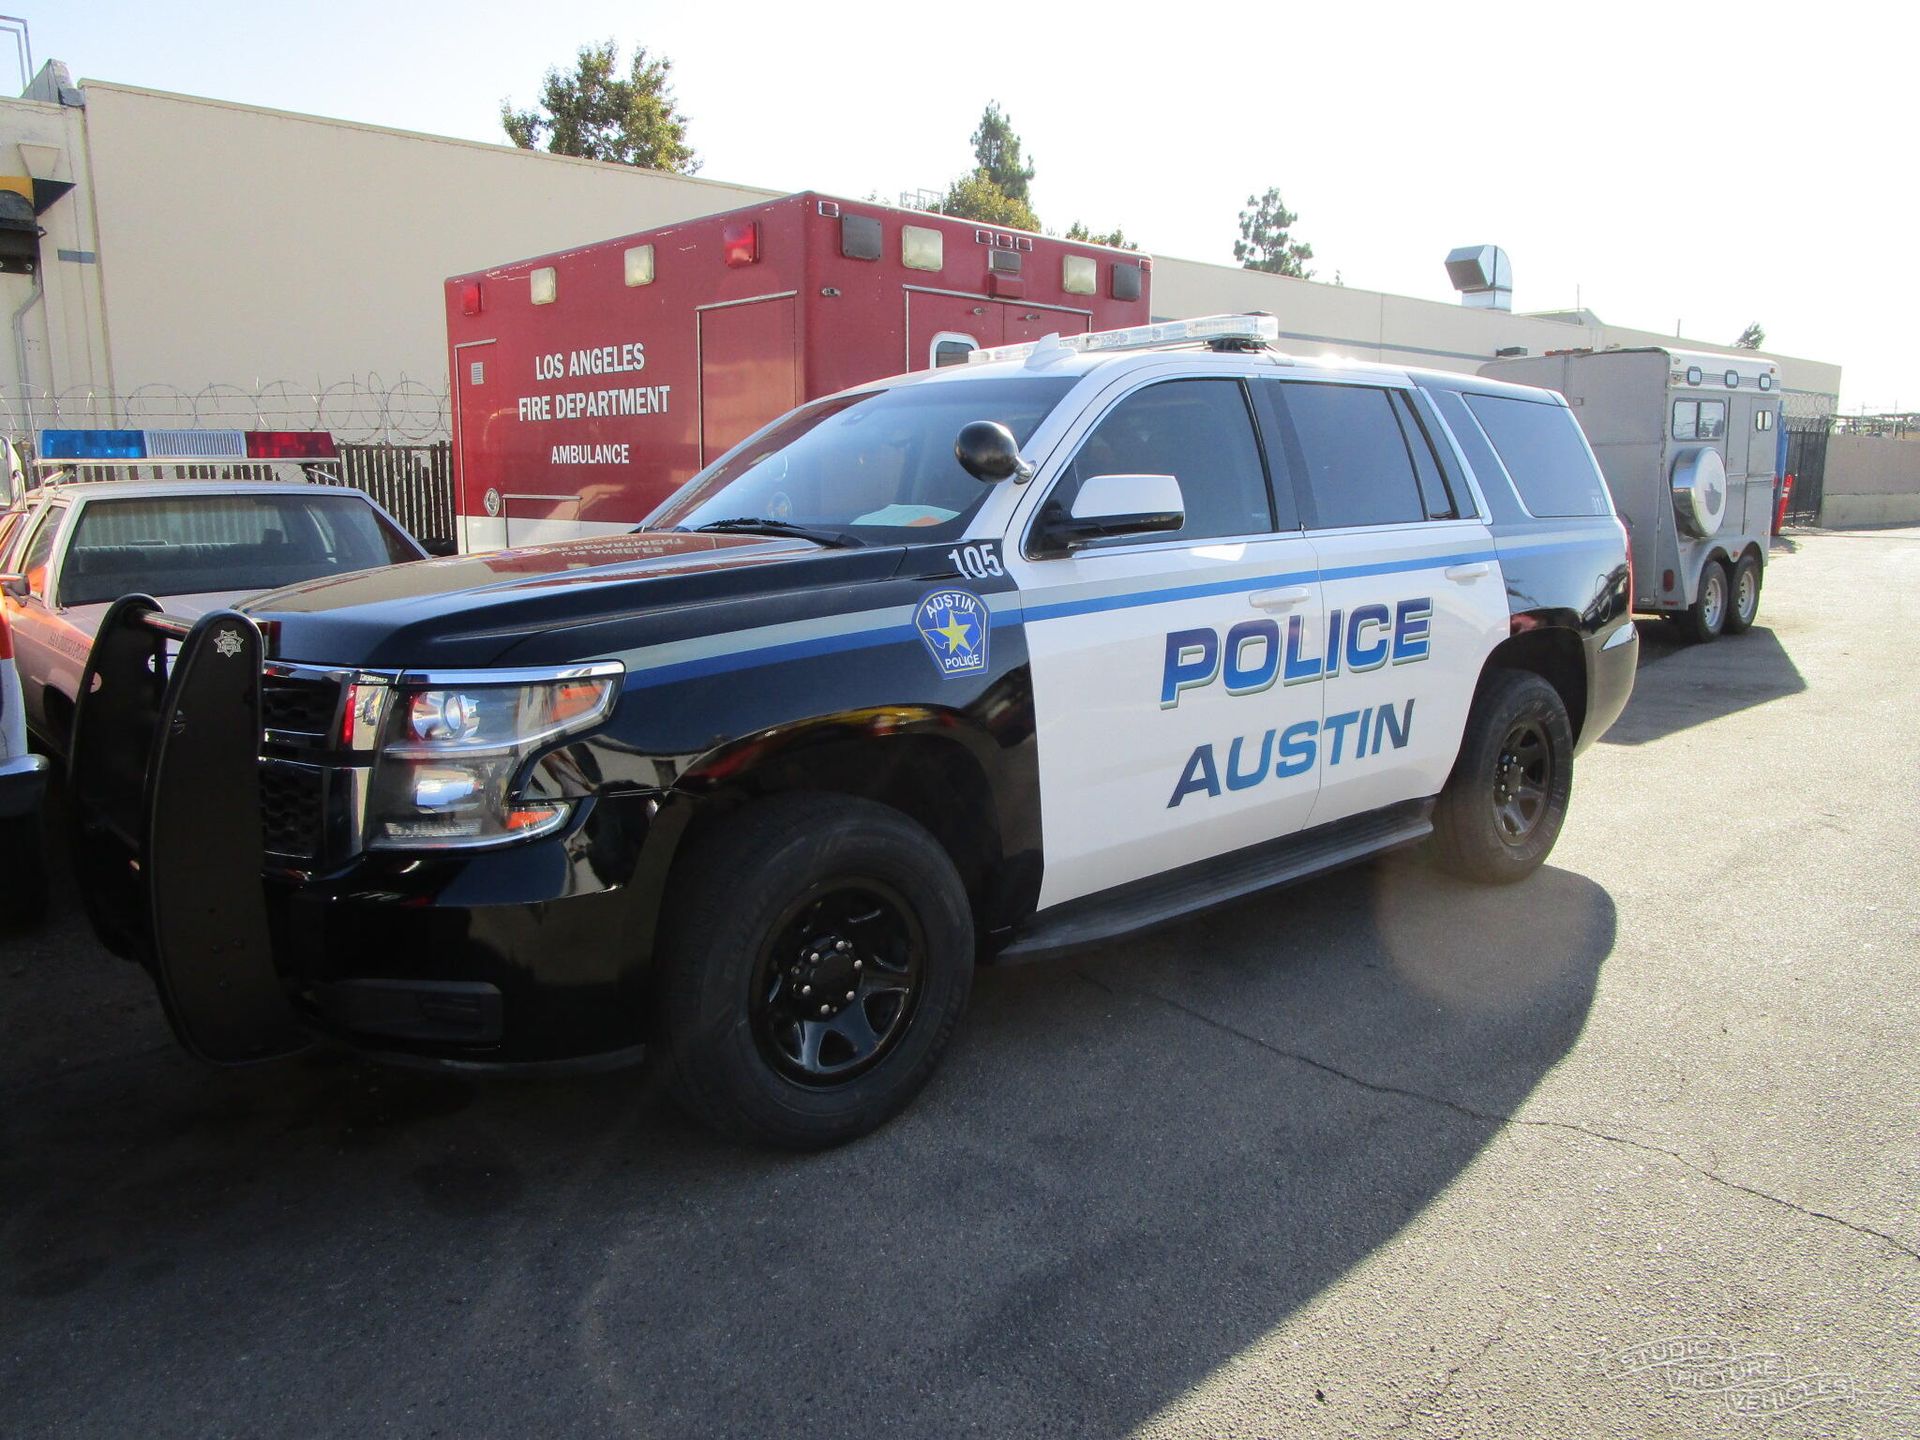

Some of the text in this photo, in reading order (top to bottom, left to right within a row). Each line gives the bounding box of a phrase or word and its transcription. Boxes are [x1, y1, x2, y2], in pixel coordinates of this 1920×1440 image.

[535, 342, 645, 381] LOS ANGELES
[518, 385, 670, 421] FIRE DEPARTMENT
[551, 444, 630, 464] AMBULANCE
[948, 543, 1004, 580] 105
[925, 594, 976, 619] AUSTIN
[945, 654, 981, 669] POLICE
[1160, 597, 1433, 710] POLICE
[1166, 698, 1415, 809] AUSTIN
